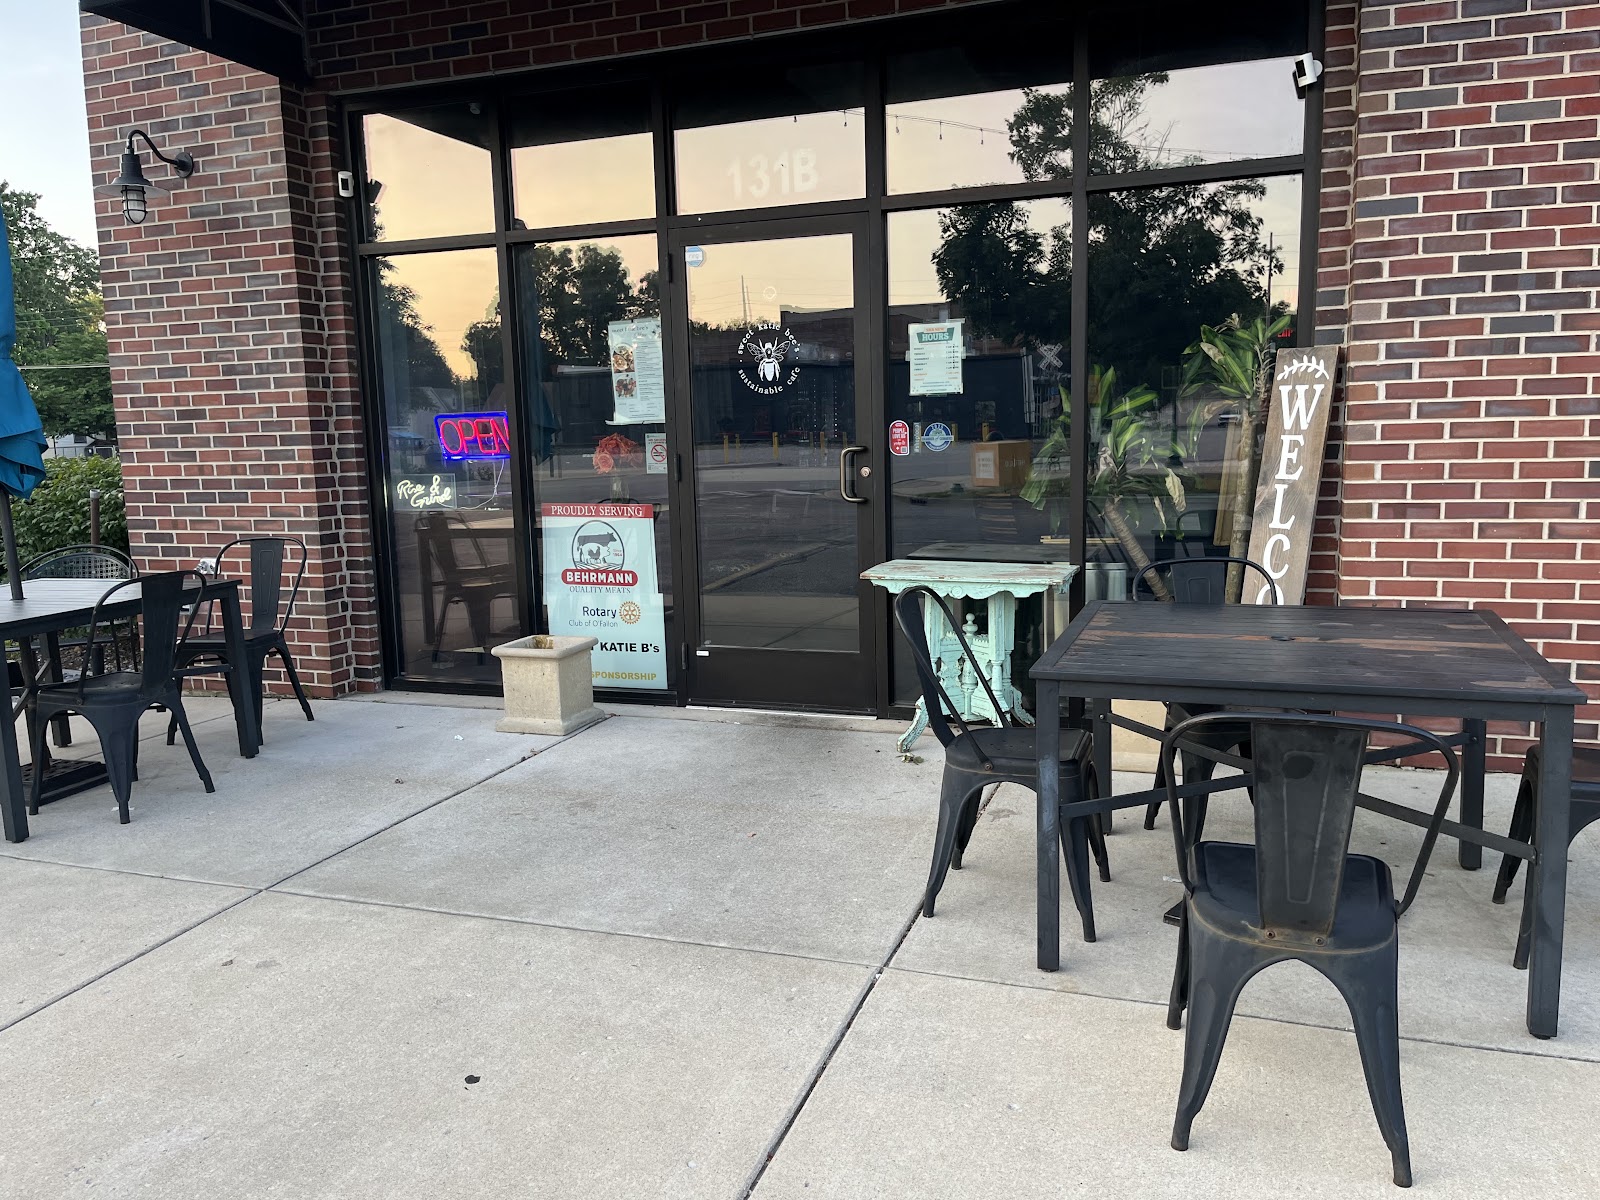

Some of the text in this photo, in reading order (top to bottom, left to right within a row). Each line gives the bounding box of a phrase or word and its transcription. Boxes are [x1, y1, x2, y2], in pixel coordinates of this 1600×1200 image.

[727, 147, 819, 199] 131B
[737, 322, 801, 355] sweet katie bee's
[922, 332, 950, 342] HOURS
[738, 366, 801, 395] sustainable cafe
[440, 418, 510, 454] OPEN
[551, 505, 643, 517] PROUDLY SERVING
[566, 571, 633, 584] BEHRMANN
[569, 585, 631, 594] QUALITY MEATS
[582, 606, 617, 619] Rotary
[568, 619, 582, 627] Club
[592, 620, 619, 628] O'Fallon
[600, 642, 637, 652] KATIE
[641, 643, 660, 653] B's
